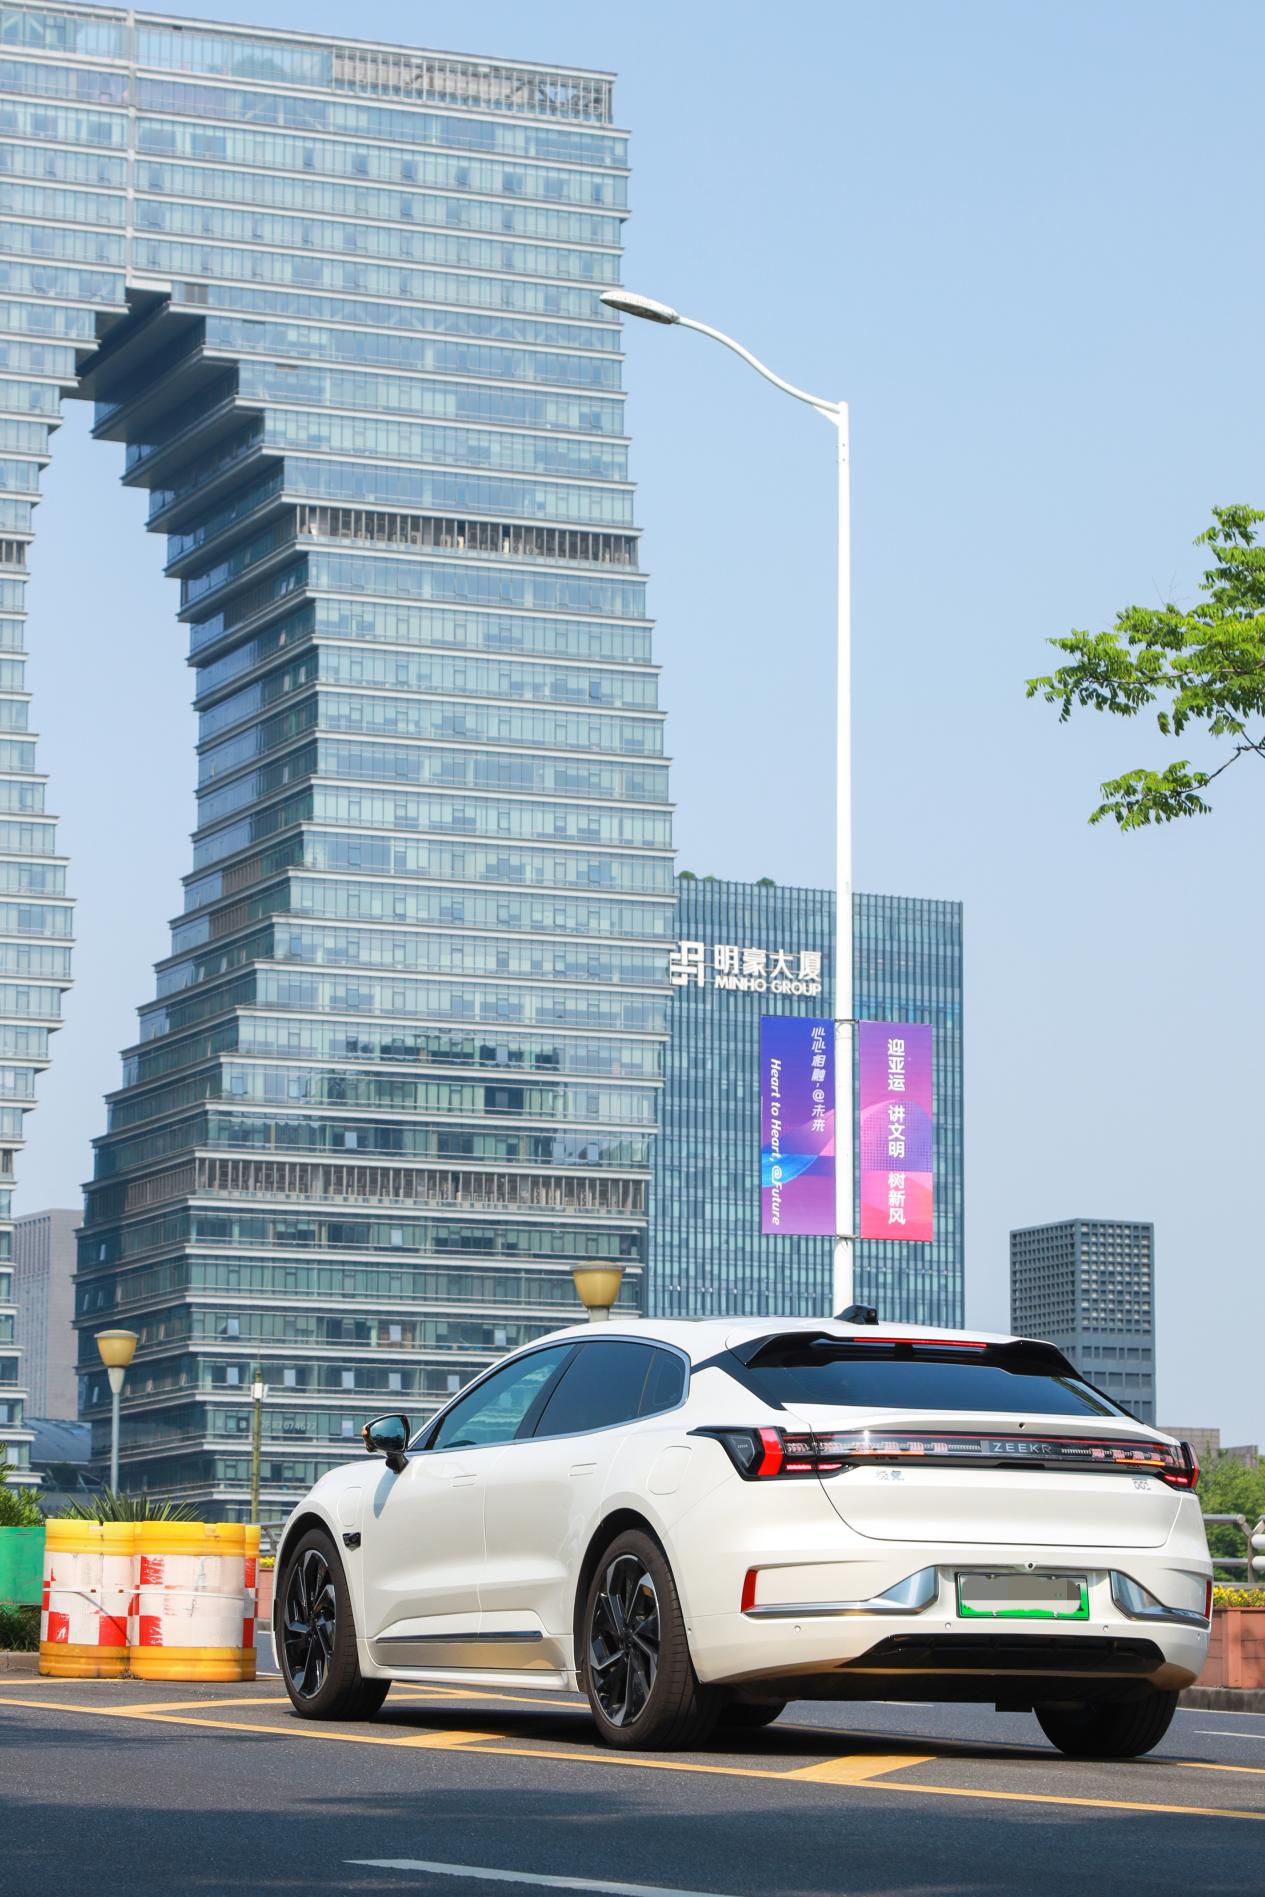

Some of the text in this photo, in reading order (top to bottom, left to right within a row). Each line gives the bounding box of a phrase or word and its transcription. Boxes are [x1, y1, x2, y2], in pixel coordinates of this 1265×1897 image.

[714, 976, 821, 996] MINHO GROUP
[769, 1058, 782, 1226] Heart to Heart, @Future
[888, 1039, 905, 1225] 迎亚运 讲文明 树新风
[992, 1442, 1052, 1453] ZEEKR
